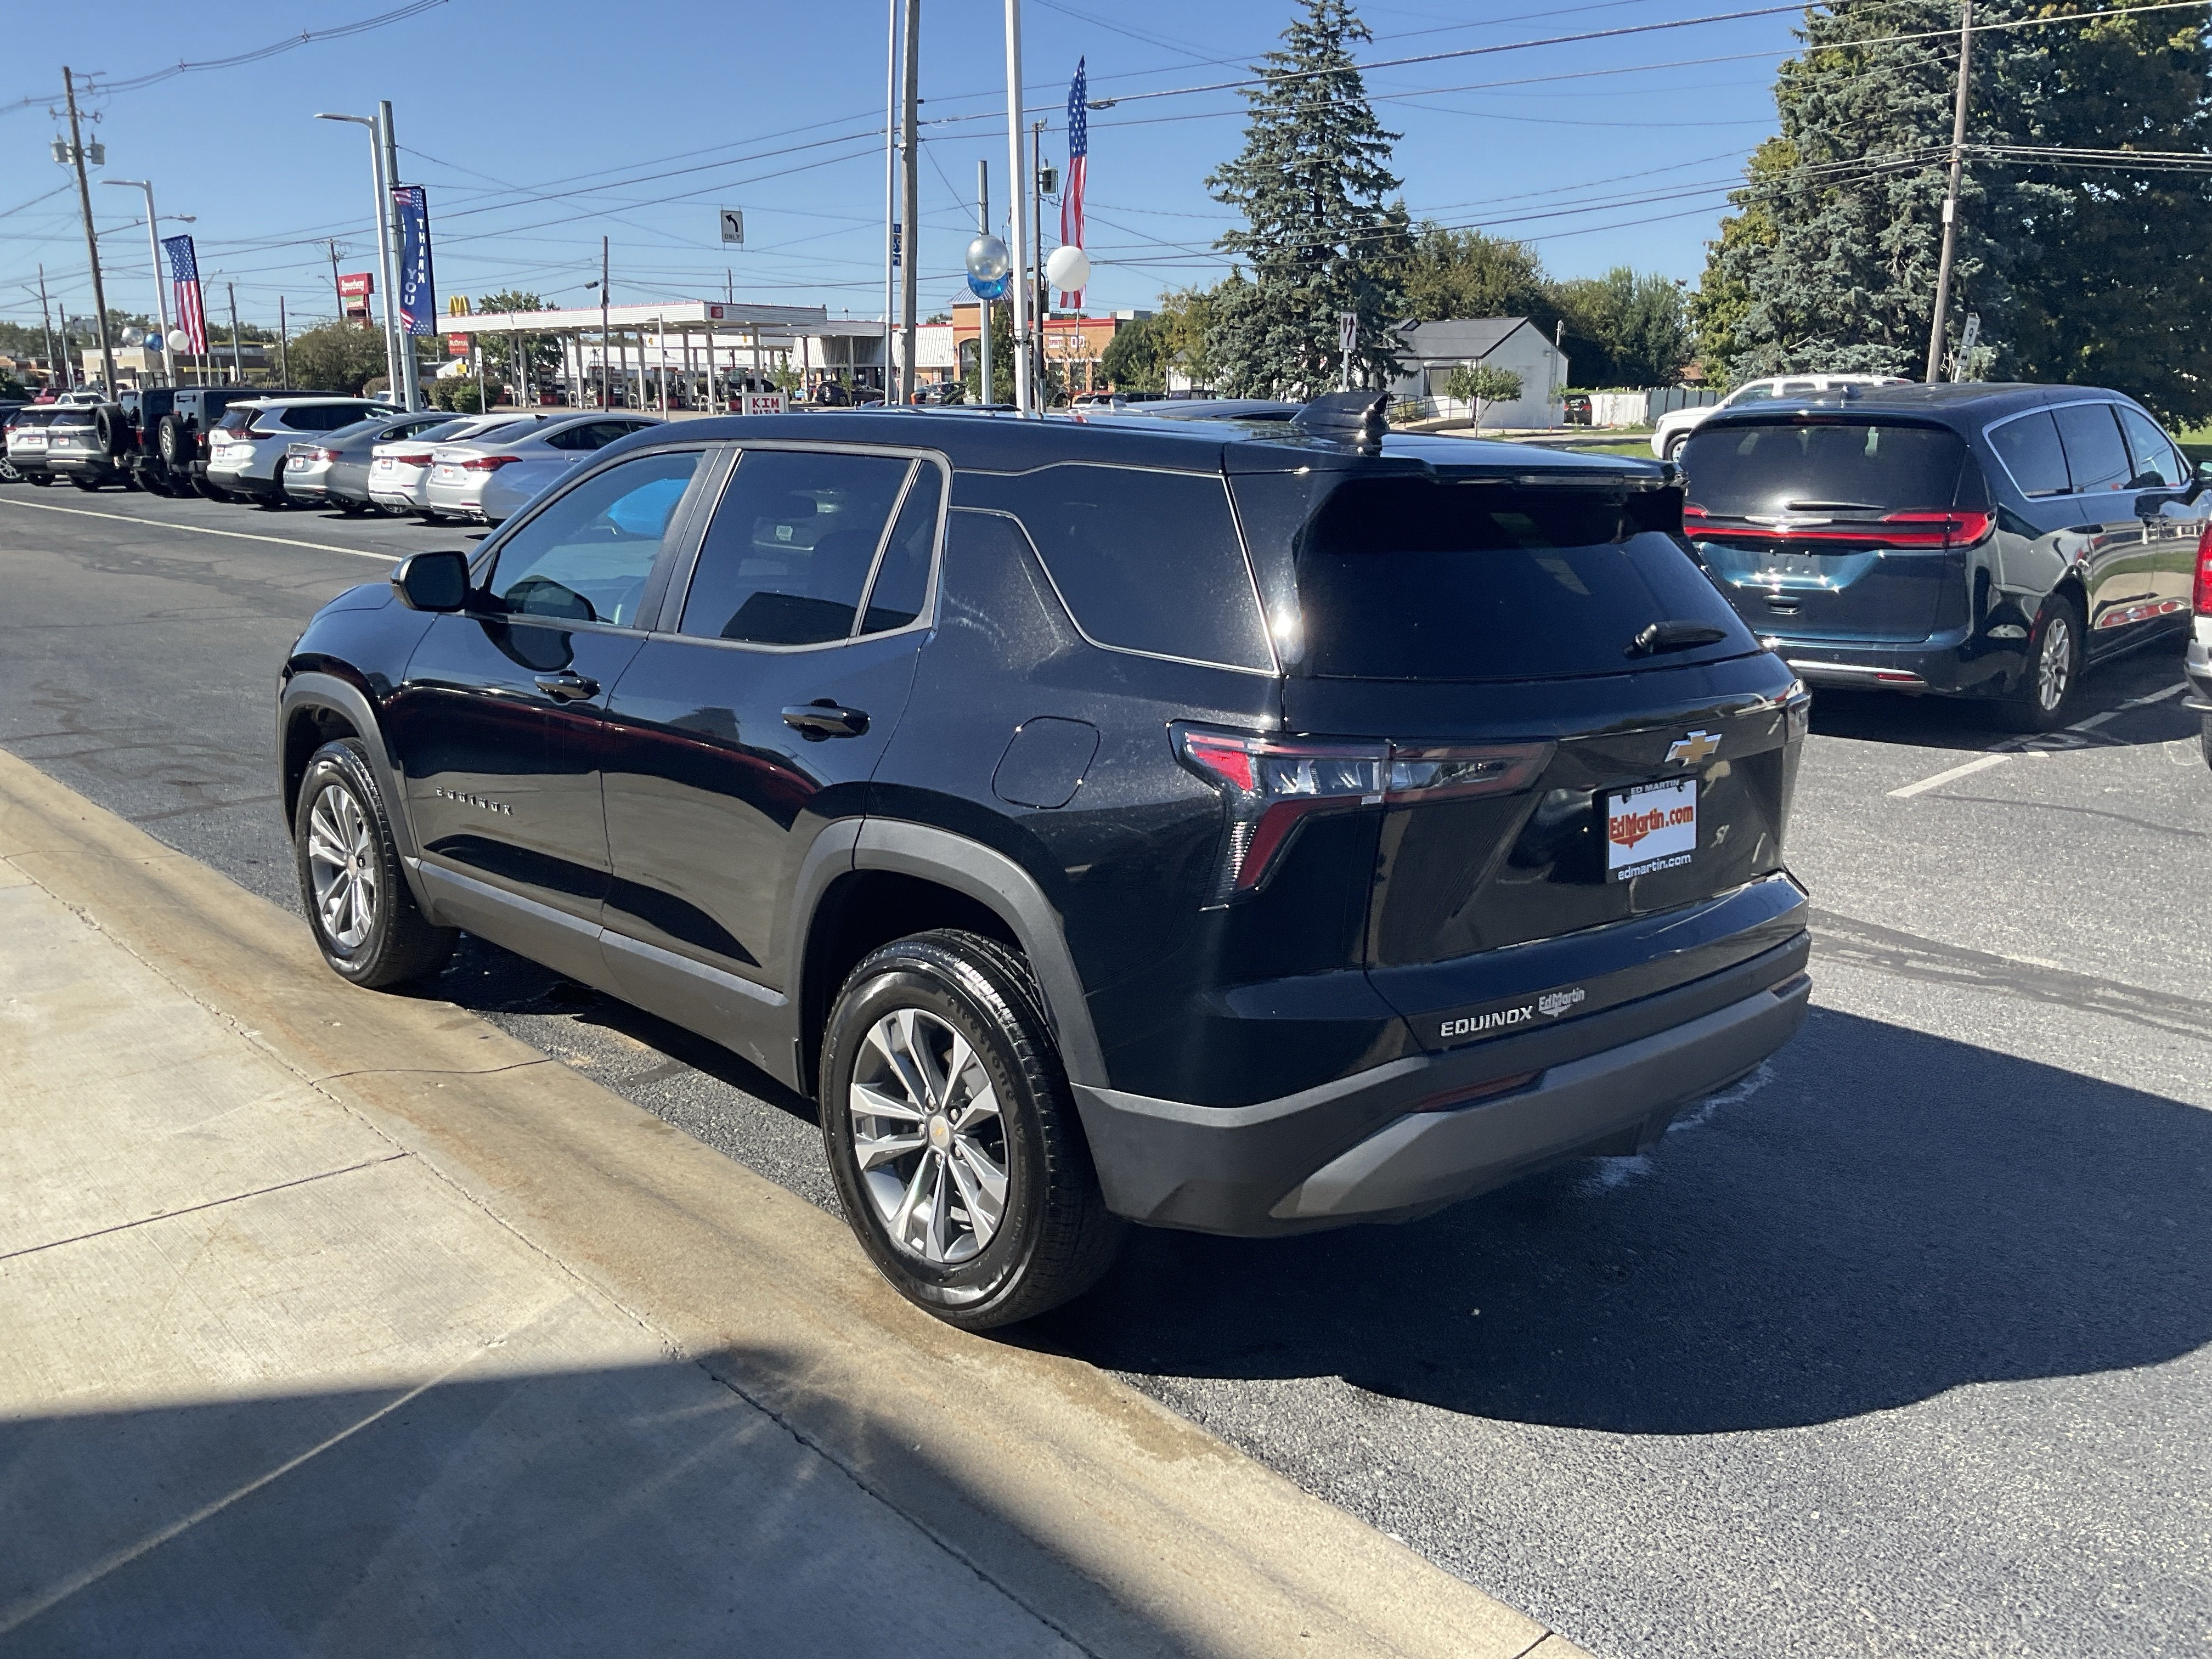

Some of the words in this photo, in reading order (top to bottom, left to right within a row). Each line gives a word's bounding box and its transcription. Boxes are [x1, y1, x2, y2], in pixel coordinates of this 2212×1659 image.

[341, 279, 365, 294] Speedway
[752, 398, 779, 408] KIM
[1630, 786, 1643, 795] ED
[1645, 779, 1680, 792] MARTIN
[436, 786, 514, 816] EQUINOX
[1609, 805, 1694, 838] EdMartin.com
[1618, 854, 1691, 881] edmartin.com
[1538, 987, 1585, 1012] EdMartin
[1441, 1005, 1533, 1037] EQUINOX
